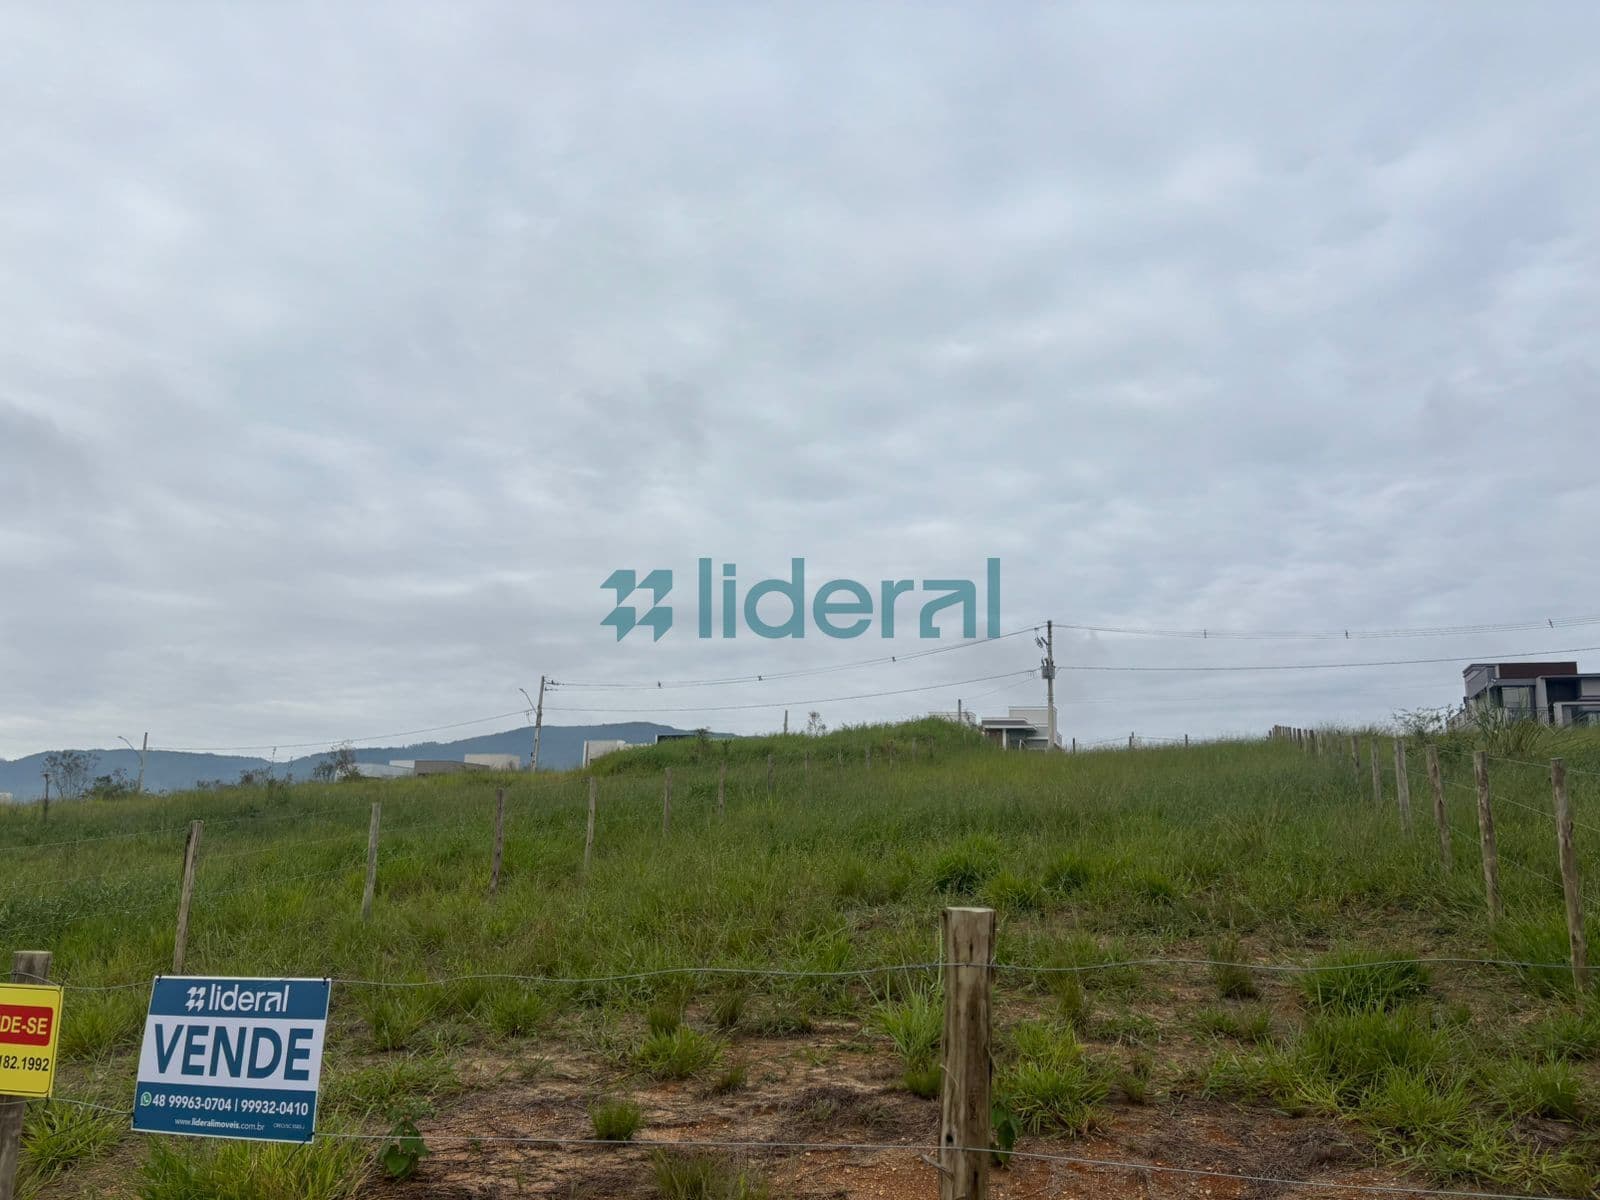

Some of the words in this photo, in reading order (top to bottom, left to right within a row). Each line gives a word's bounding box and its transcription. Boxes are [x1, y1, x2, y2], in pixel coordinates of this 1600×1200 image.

[208, 983, 290, 1013] lideral
[0, 1014, 48, 1035] DE-SE
[154, 1023, 314, 1081] VENDE
[152, 1093, 166, 1107] 48
[168, 1094, 232, 1111] 99963-0704
[241, 1099, 309, 1116] 99932-0410
[174, 1117, 265, 1131] www.lideralimoveis.com.br
